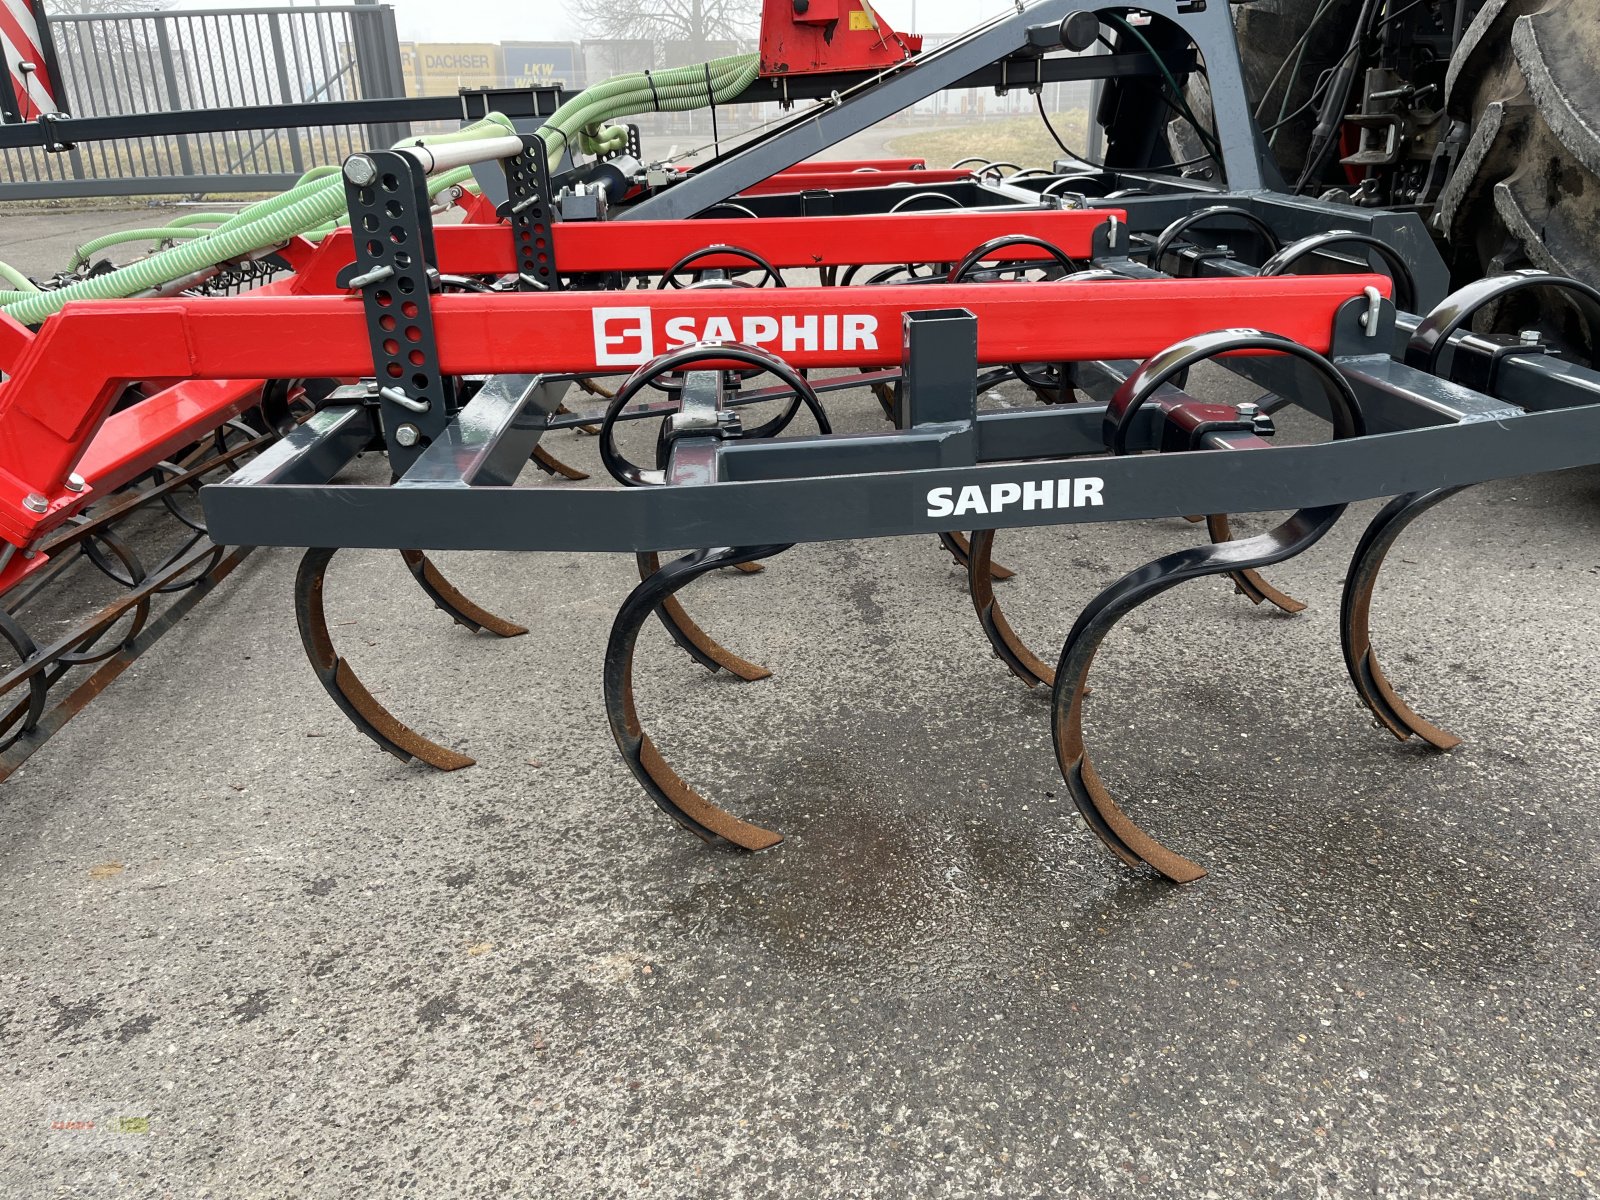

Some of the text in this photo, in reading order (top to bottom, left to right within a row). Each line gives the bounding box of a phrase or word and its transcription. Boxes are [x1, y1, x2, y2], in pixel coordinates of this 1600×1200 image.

[425, 54, 490, 69] DACHSER
[524, 63, 554, 75] LKW
[664, 314, 879, 352] SAPHIR
[926, 476, 1105, 518] SAPHIR
